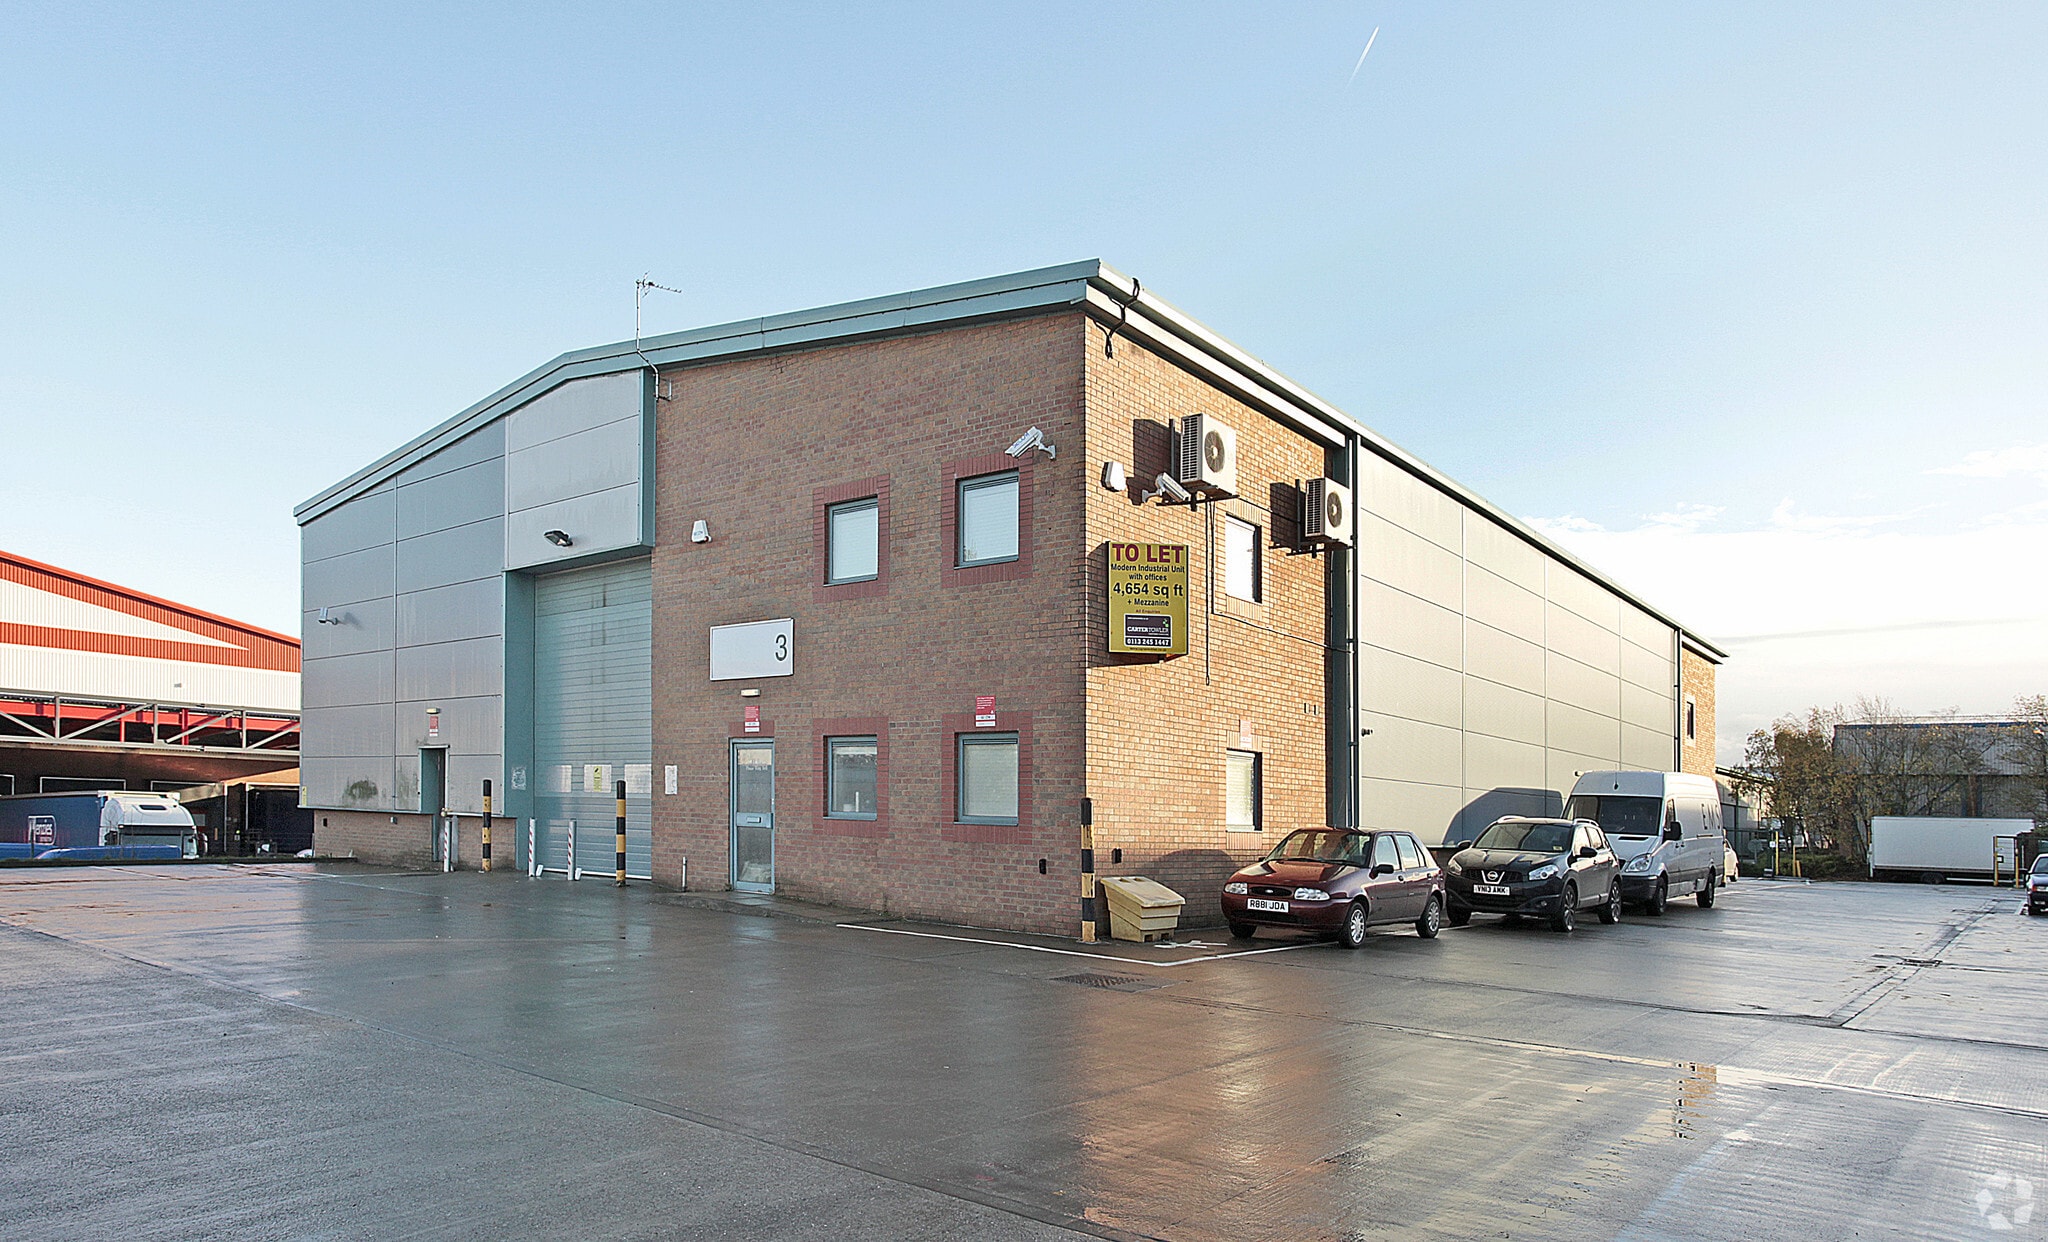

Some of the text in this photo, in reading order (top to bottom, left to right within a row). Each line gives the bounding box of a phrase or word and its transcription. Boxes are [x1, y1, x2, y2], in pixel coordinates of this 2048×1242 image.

[1112, 543, 1184, 563] TO LET
[1111, 563, 1185, 573] Modern Industrial Unit
[1144, 573, 1168, 581] offices
[1113, 582, 1184, 599] 4,654 sq ft
[1134, 598, 1169, 607] Mezzanine
[775, 633, 788, 662] 3
[1269, 901, 1286, 911] JDA
